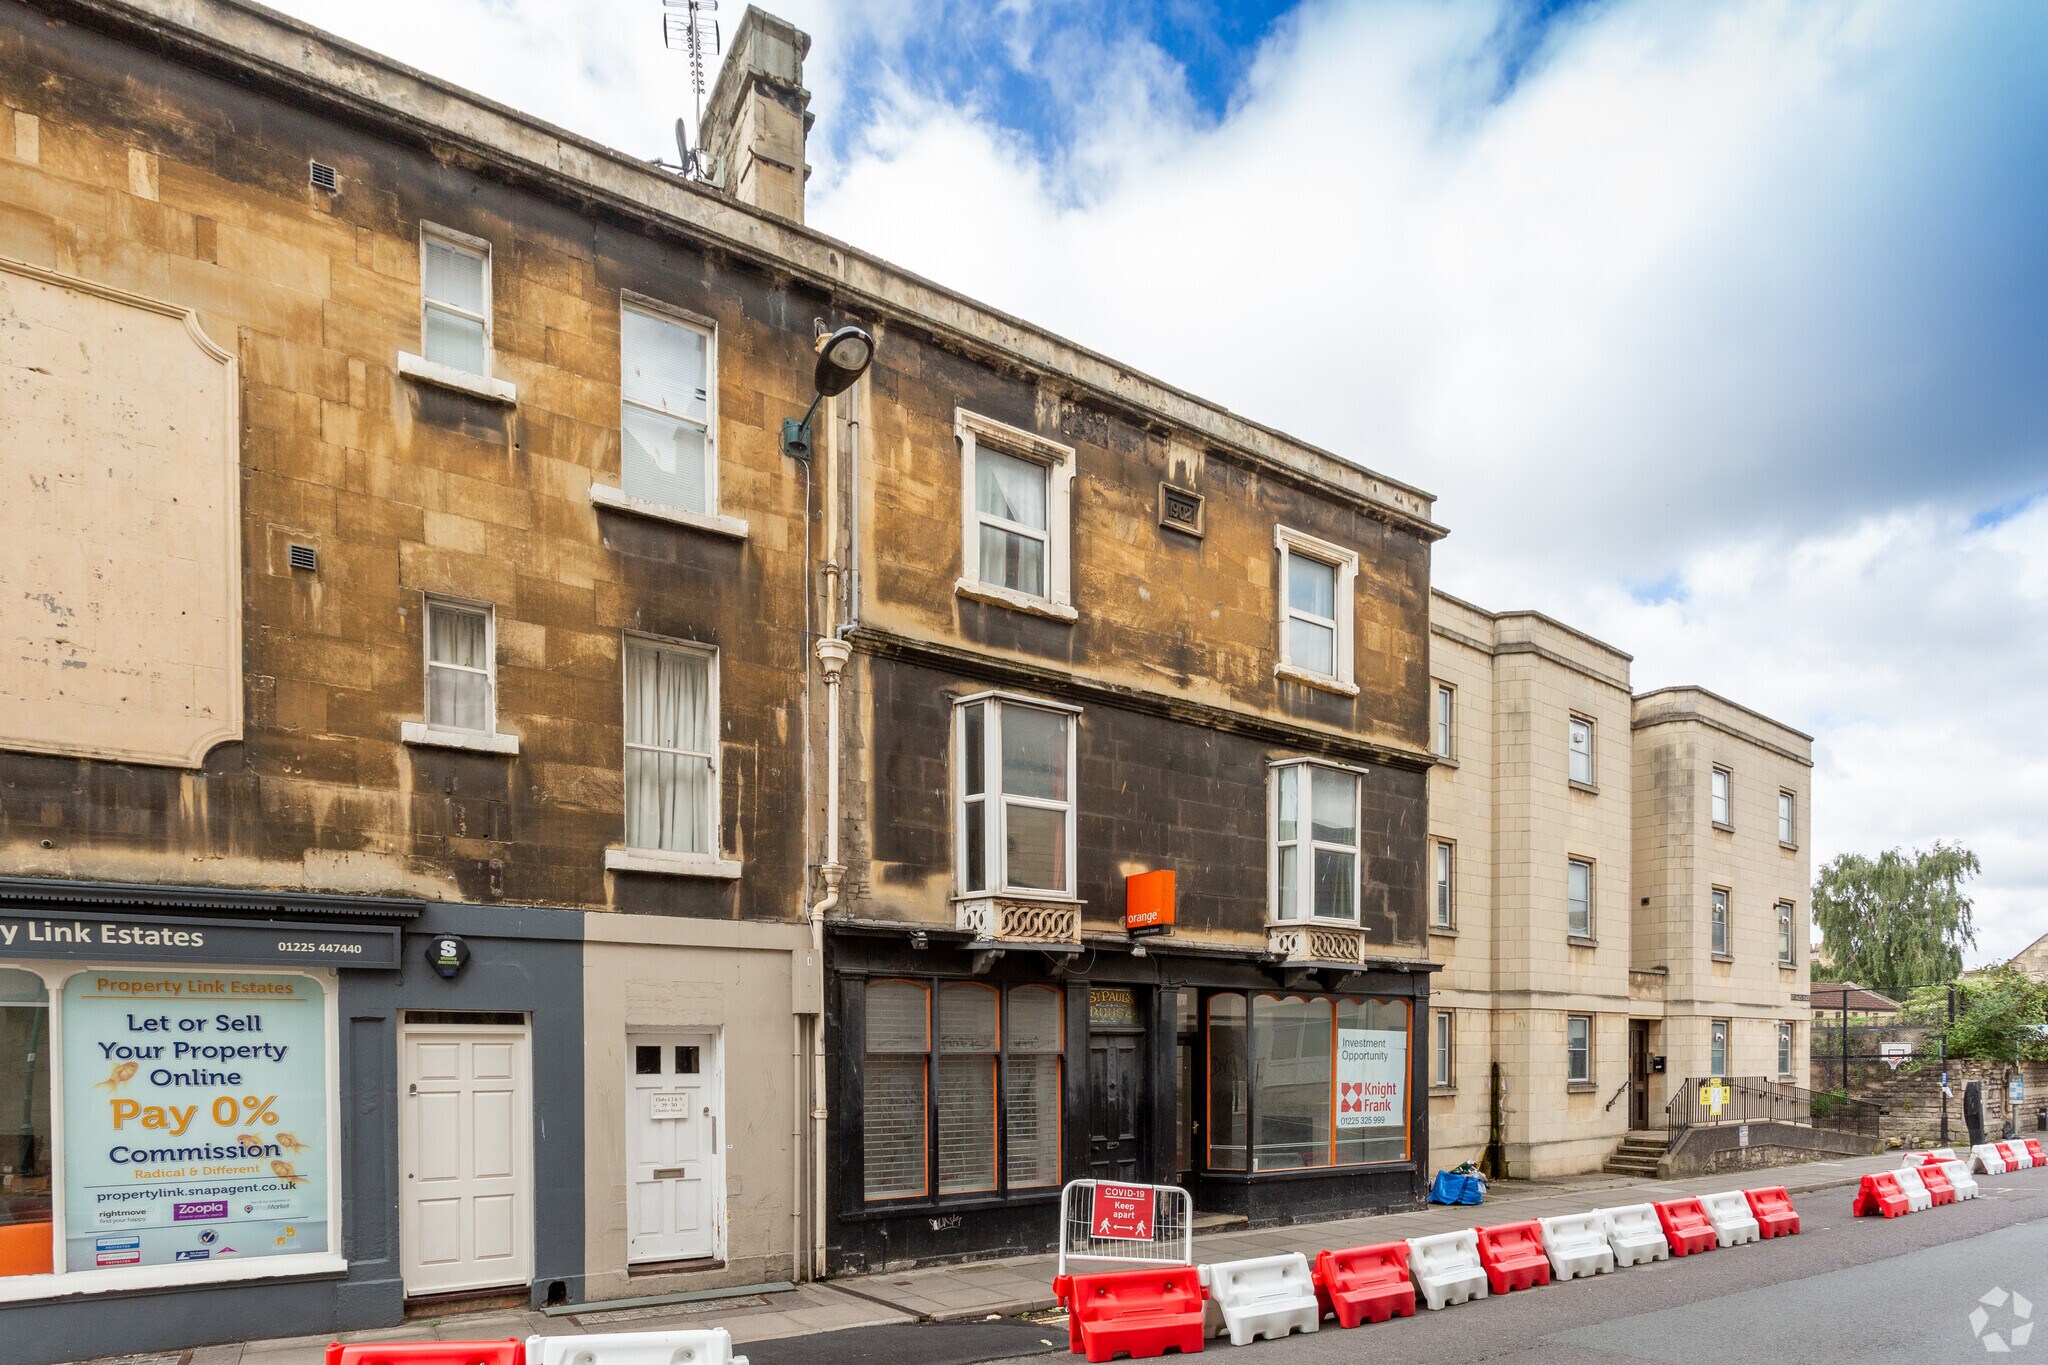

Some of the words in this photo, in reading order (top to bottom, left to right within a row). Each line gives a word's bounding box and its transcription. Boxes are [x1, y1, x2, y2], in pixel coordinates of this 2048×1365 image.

[1128, 911, 1158, 924] orange
[28, 921, 92, 943] Link
[101, 924, 204, 947] Estates
[278, 941, 315, 952] 01225
[318, 943, 362, 954] 447440
[441, 940, 457, 957] S
[97, 978, 183, 995] Property
[188, 979, 224, 993] Link
[231, 981, 294, 995] Estates
[127, 1014, 170, 1032] Let
[178, 1018, 207, 1032] or
[216, 1014, 263, 1032] Sell
[1342, 1038, 1386, 1048] Investment
[98, 1041, 164, 1060] Your
[173, 1041, 288, 1063] Property
[1341, 1050, 1388, 1062] Opportunity
[150, 1068, 243, 1087] Online
[1364, 1082, 1397, 1098] Knight
[1364, 1099, 1391, 1112] Frank
[110, 1098, 198, 1136] Pay
[212, 1095, 279, 1127] 0%
[1340, 1117, 1359, 1125] 01225
[1361, 1116, 1372, 1124] 325
[1373, 1116, 1385, 1124] 999
[109, 1142, 281, 1164] Commission
[134, 1167, 185, 1179] Radical
[189, 1166, 198, 1177] &
[203, 1164, 260, 1176] Different
[97, 1181, 297, 1203] propertylink.snapagent.co.uk
[1105, 1188, 1145, 1198] COVID-19
[179, 1203, 223, 1214] Zoopla
[1114, 1201, 1135, 1211] Keep
[99, 1209, 147, 1219] rightmove
[1113, 1211, 1135, 1219] apart
